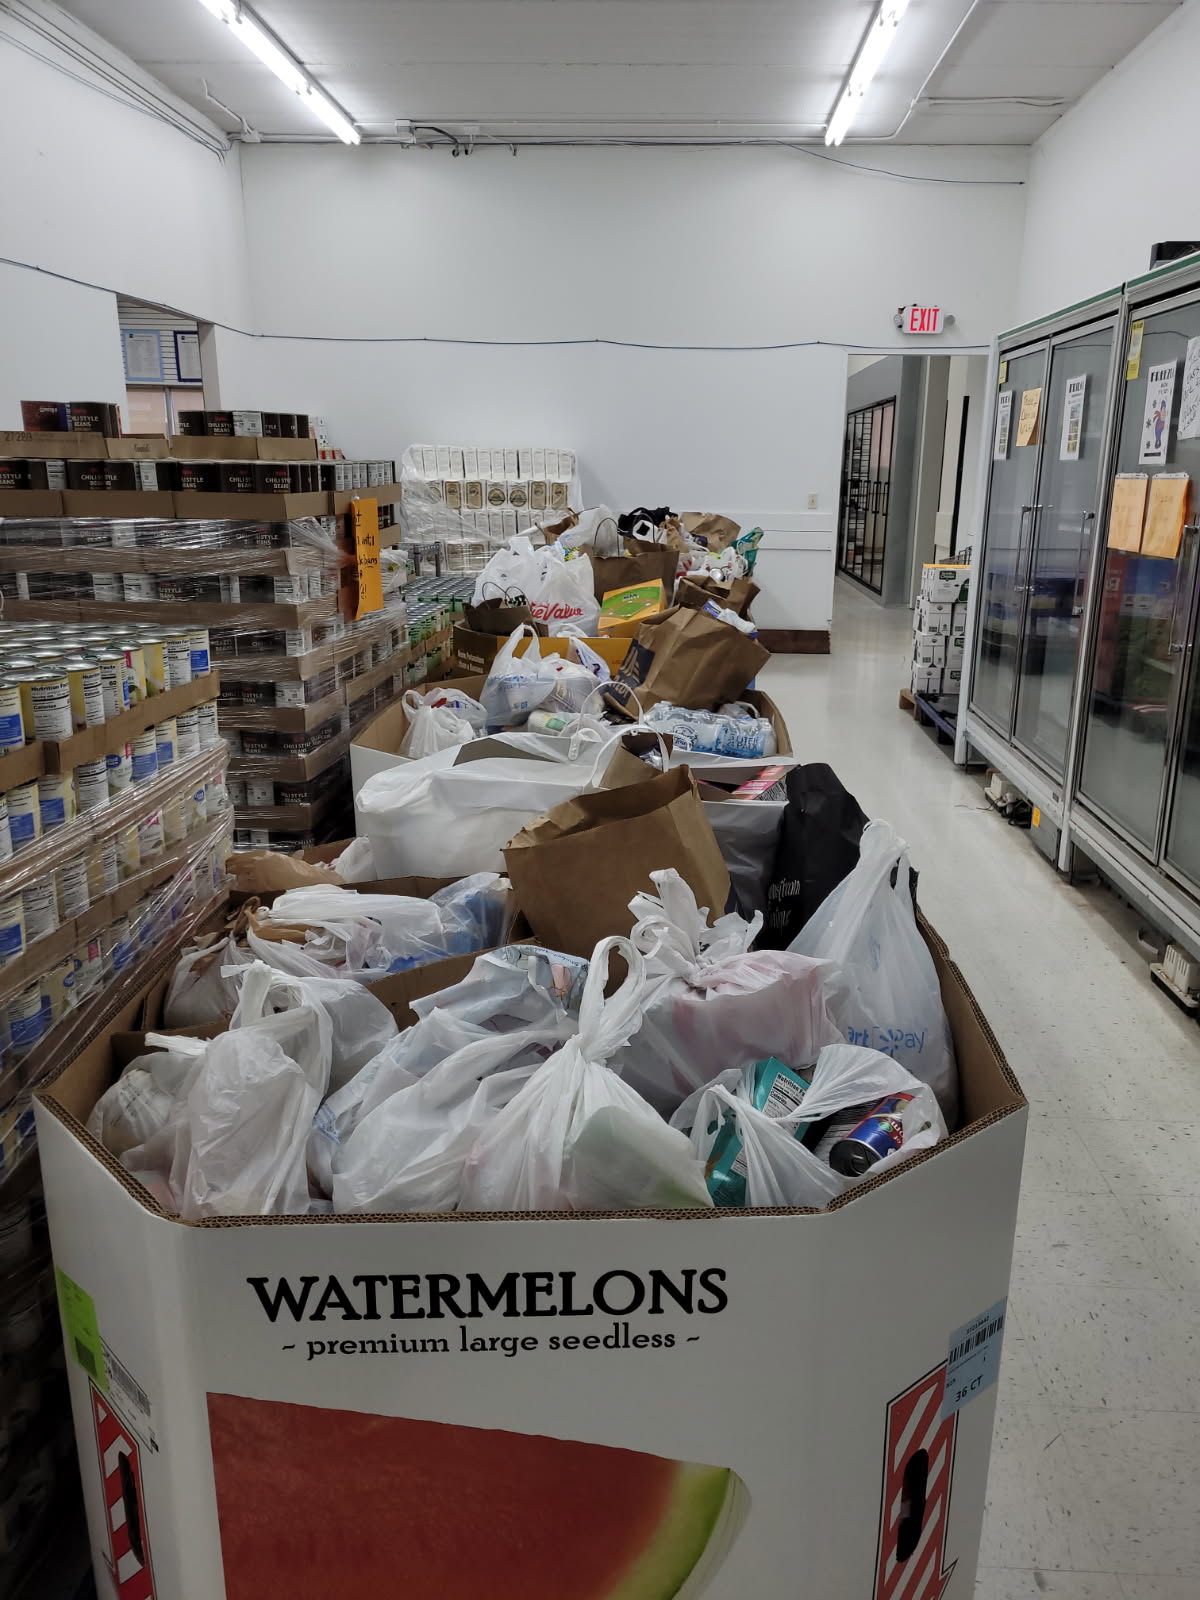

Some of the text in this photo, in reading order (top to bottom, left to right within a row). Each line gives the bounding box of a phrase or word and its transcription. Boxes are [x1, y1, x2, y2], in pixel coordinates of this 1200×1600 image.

[910, 308, 940, 331] EXIT
[776, 1073, 800, 1092] Nutrition
[246, 1268, 729, 1322] WATERMELONS
[306, 1332, 450, 1361] premium
[459, 1325, 539, 1358] large
[548, 1321, 676, 1352] seedless
[955, 1374, 984, 1403] 36 CT
